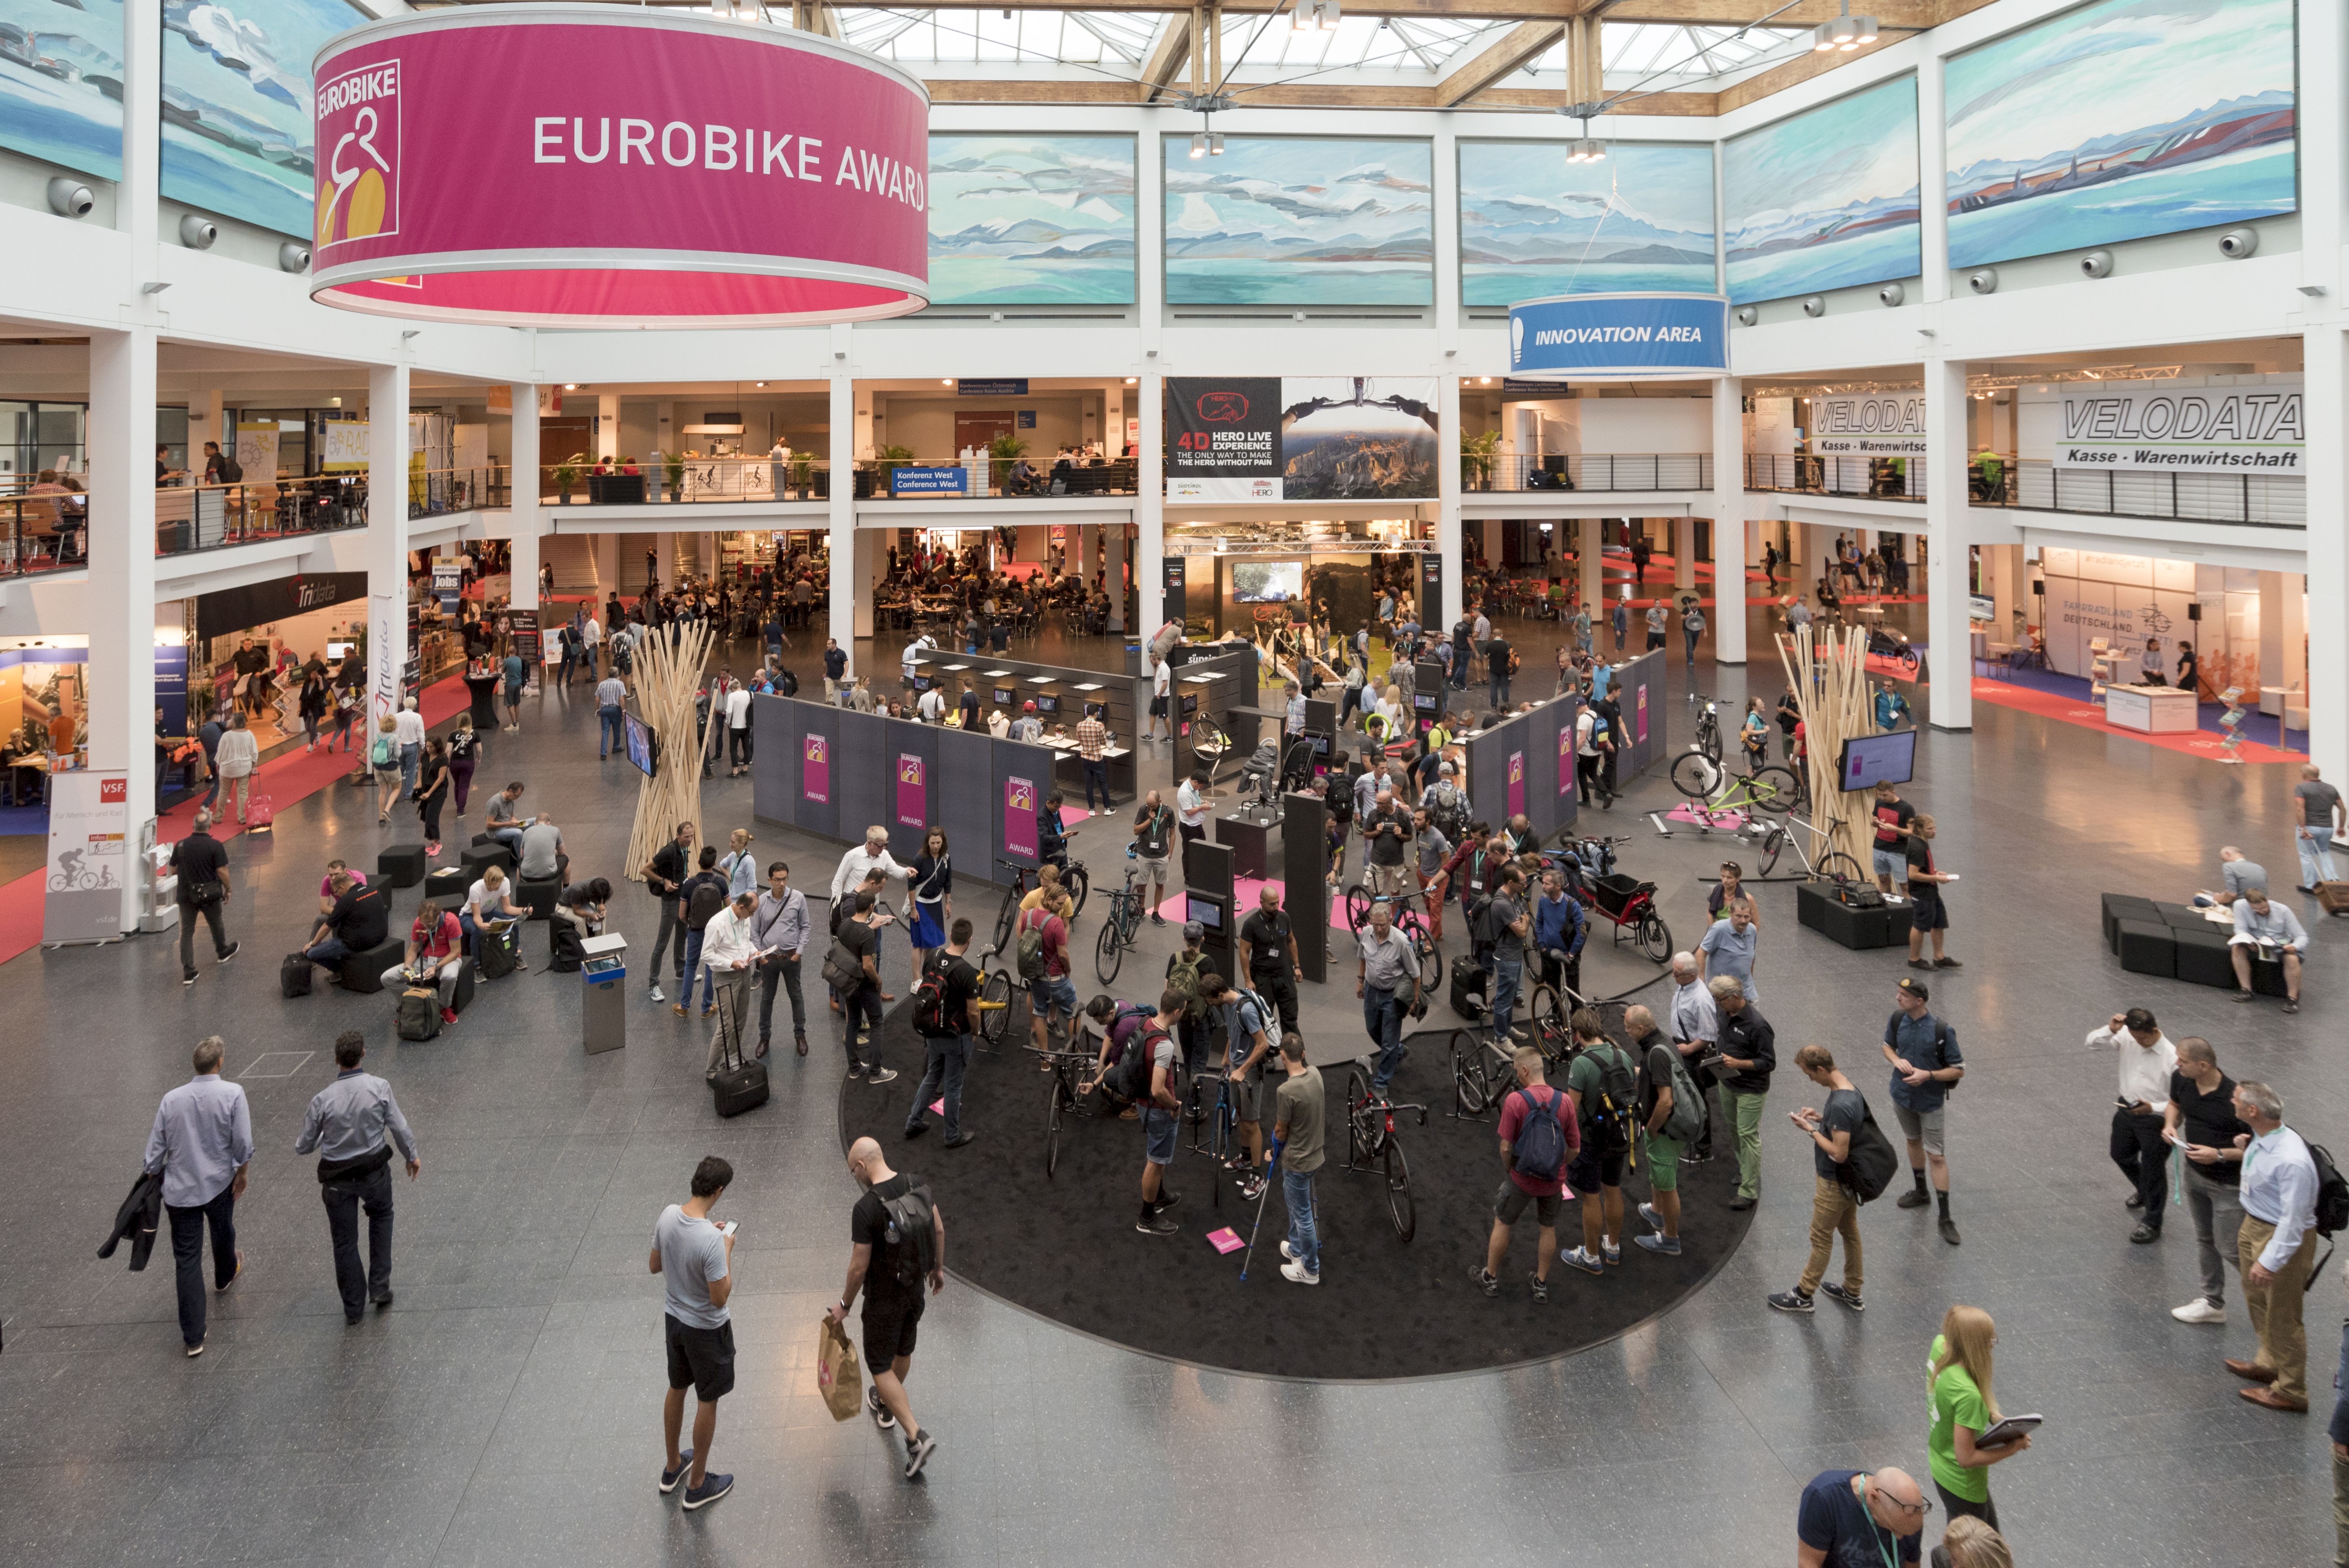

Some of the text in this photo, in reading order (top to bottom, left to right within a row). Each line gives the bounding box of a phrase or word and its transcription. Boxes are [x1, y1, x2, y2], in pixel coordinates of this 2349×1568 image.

[318, 66, 397, 121] EUROBIKE
[534, 116, 925, 212] EUROBIKE AWARD
[1536, 326, 1702, 346] INNOVATION AREA
[2065, 394, 2305, 440] VELODATA
[1178, 432, 1210, 450] 4D
[1213, 431, 1272, 441] HERO LIVE
[1213, 442, 1272, 450] EXPERIENCE
[1821, 441, 1850, 450] Kasse
[2068, 449, 2298, 467] Kasse Warenwirtschaft
[1252, 488, 1273, 497] HERO
[435, 576, 458, 587] Jobs
[299, 580, 336, 608] Tridata
[2064, 600, 2133, 619] FAHRRADLAND
[902, 755, 921, 764] EUROBIKE
[102, 783, 125, 793] VSF.
[1010, 778, 1031, 787] EUROBIKE
[807, 791, 826, 801] AWARD
[901, 815, 922, 826] AWARD
[1009, 843, 1033, 855] AWARD
